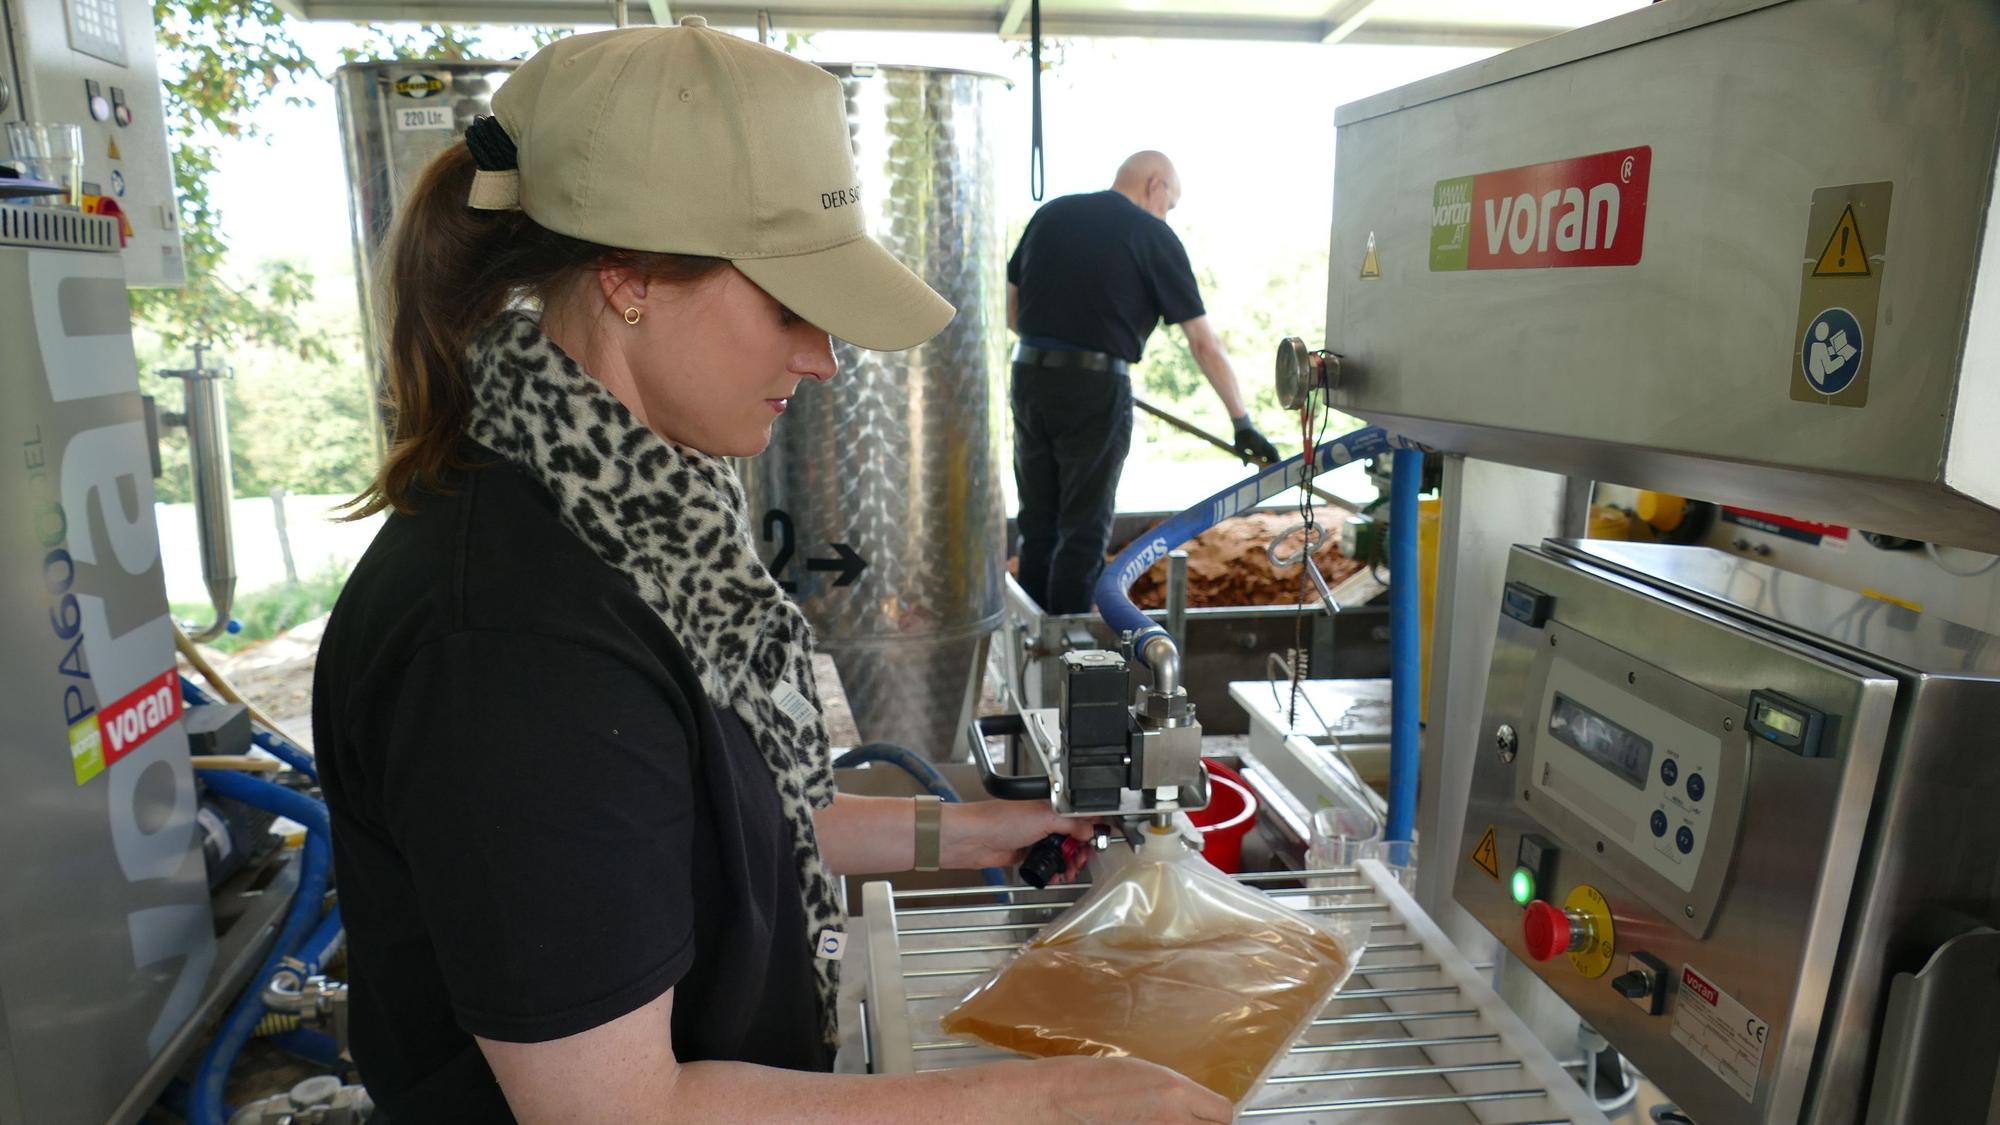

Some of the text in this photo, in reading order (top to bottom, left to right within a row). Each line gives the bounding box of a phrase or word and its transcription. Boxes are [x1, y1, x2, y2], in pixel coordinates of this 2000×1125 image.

[404, 112, 426, 127] 220
[821, 189, 848, 210] DER
[1432, 182, 1621, 255] voran voran
[763, 509, 798, 593] 2
[106, 683, 174, 753] voran
[1685, 973, 1715, 1001] voran
